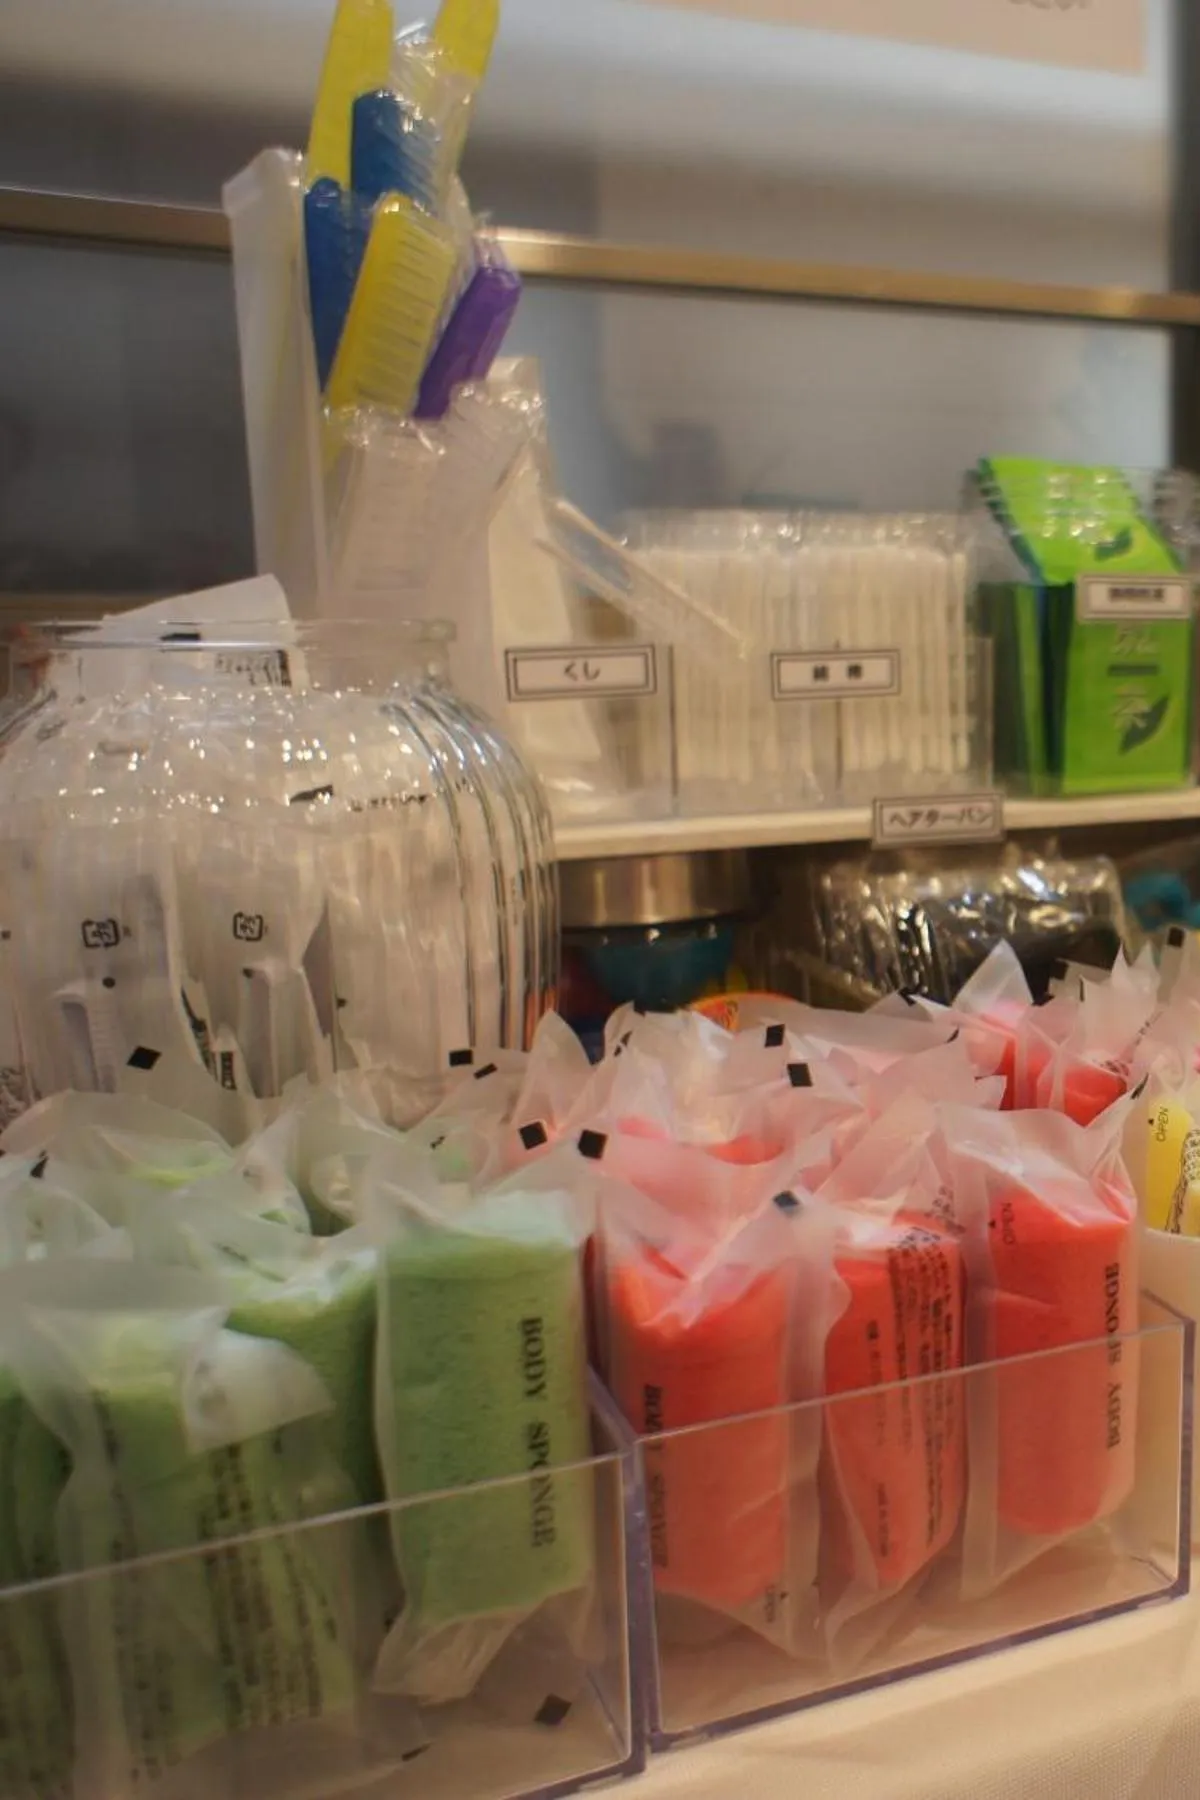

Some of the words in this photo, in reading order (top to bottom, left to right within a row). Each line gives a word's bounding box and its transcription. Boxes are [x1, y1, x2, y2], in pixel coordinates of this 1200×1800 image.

[564, 660, 601, 681] くし
[521, 1316, 546, 1397] BODY
[1107, 1382, 1122, 1449] BODY
[528, 1421, 557, 1548] SPONGE
